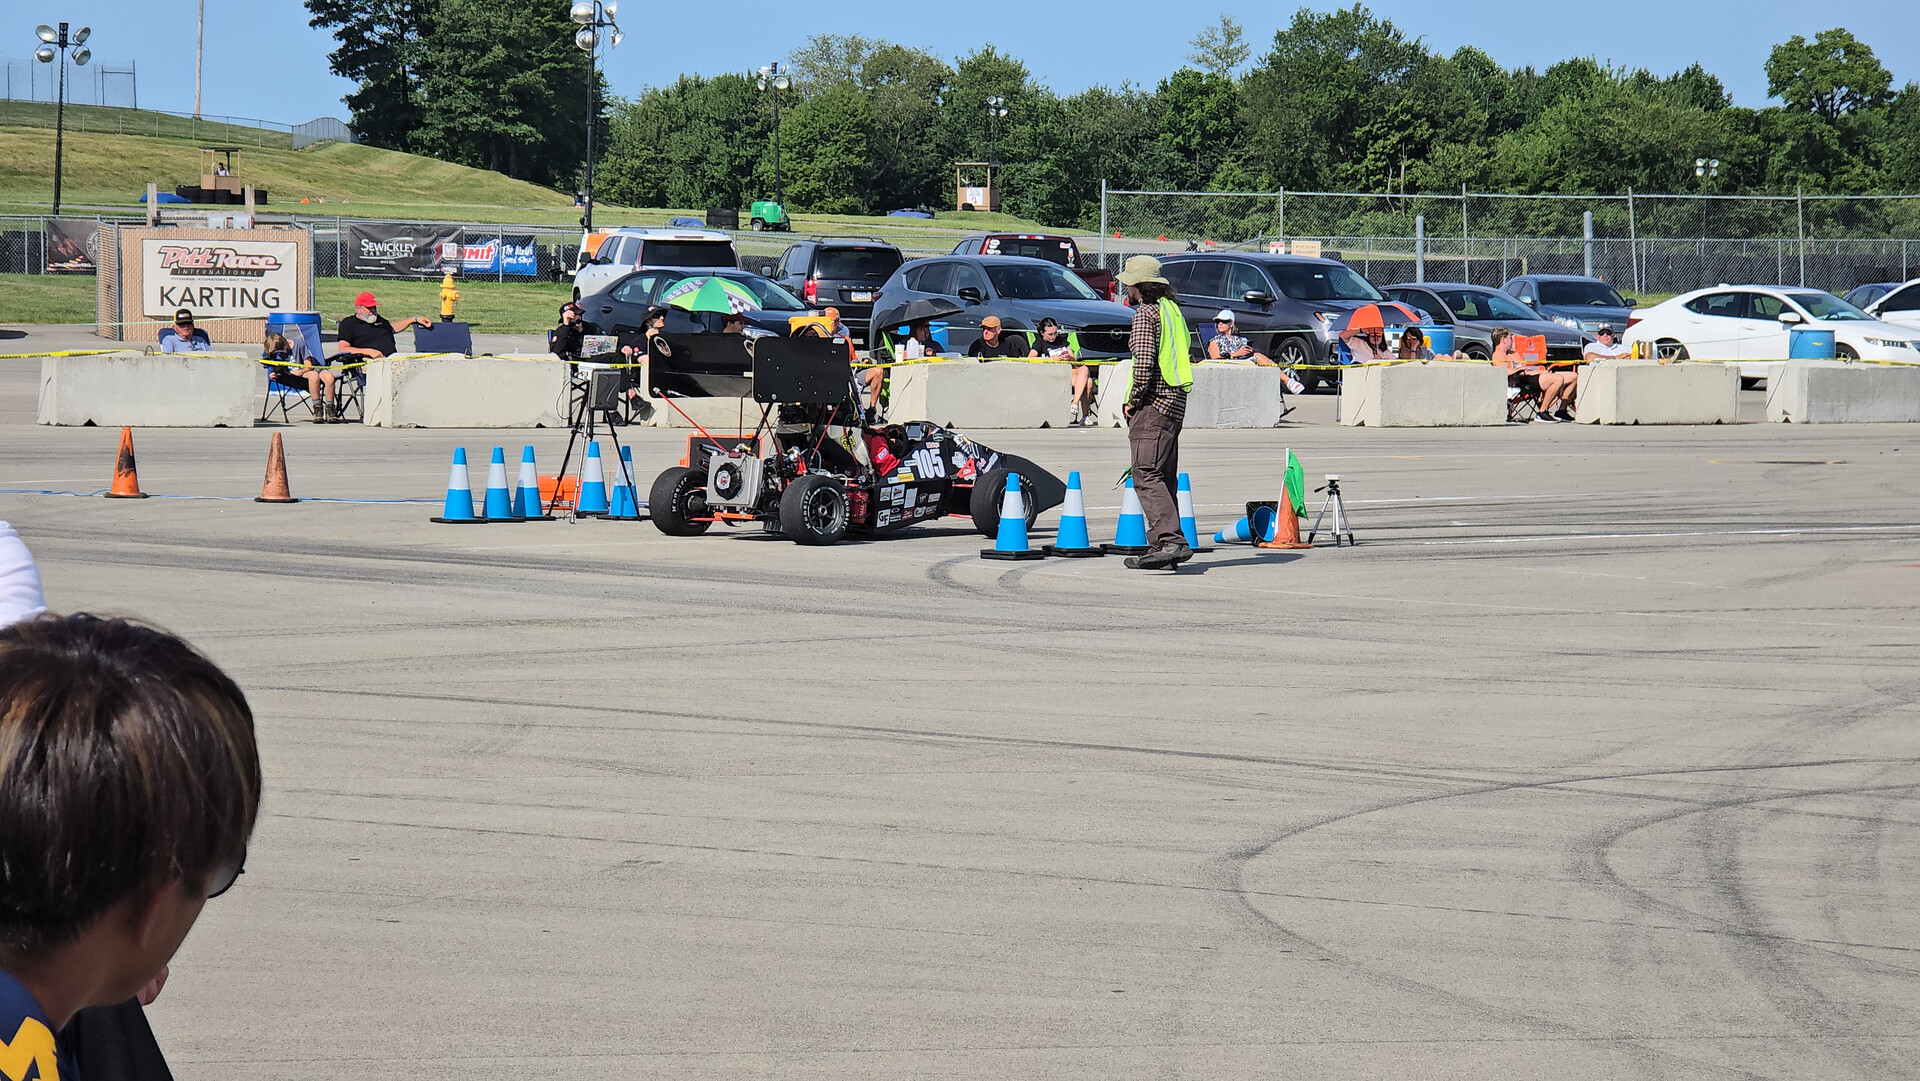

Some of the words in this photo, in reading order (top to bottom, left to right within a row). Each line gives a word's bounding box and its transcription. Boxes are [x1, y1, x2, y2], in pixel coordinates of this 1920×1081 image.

[360, 239, 417, 253] SEWICKLEY
[502, 245, 514, 258] The
[158, 246, 214, 269] Pitt
[213, 247, 283, 271] Race
[501, 255, 517, 267] Speed
[177, 268, 258, 276] INTERNATIONAL
[160, 286, 280, 309] KARTING
[912, 449, 945, 479] 105
